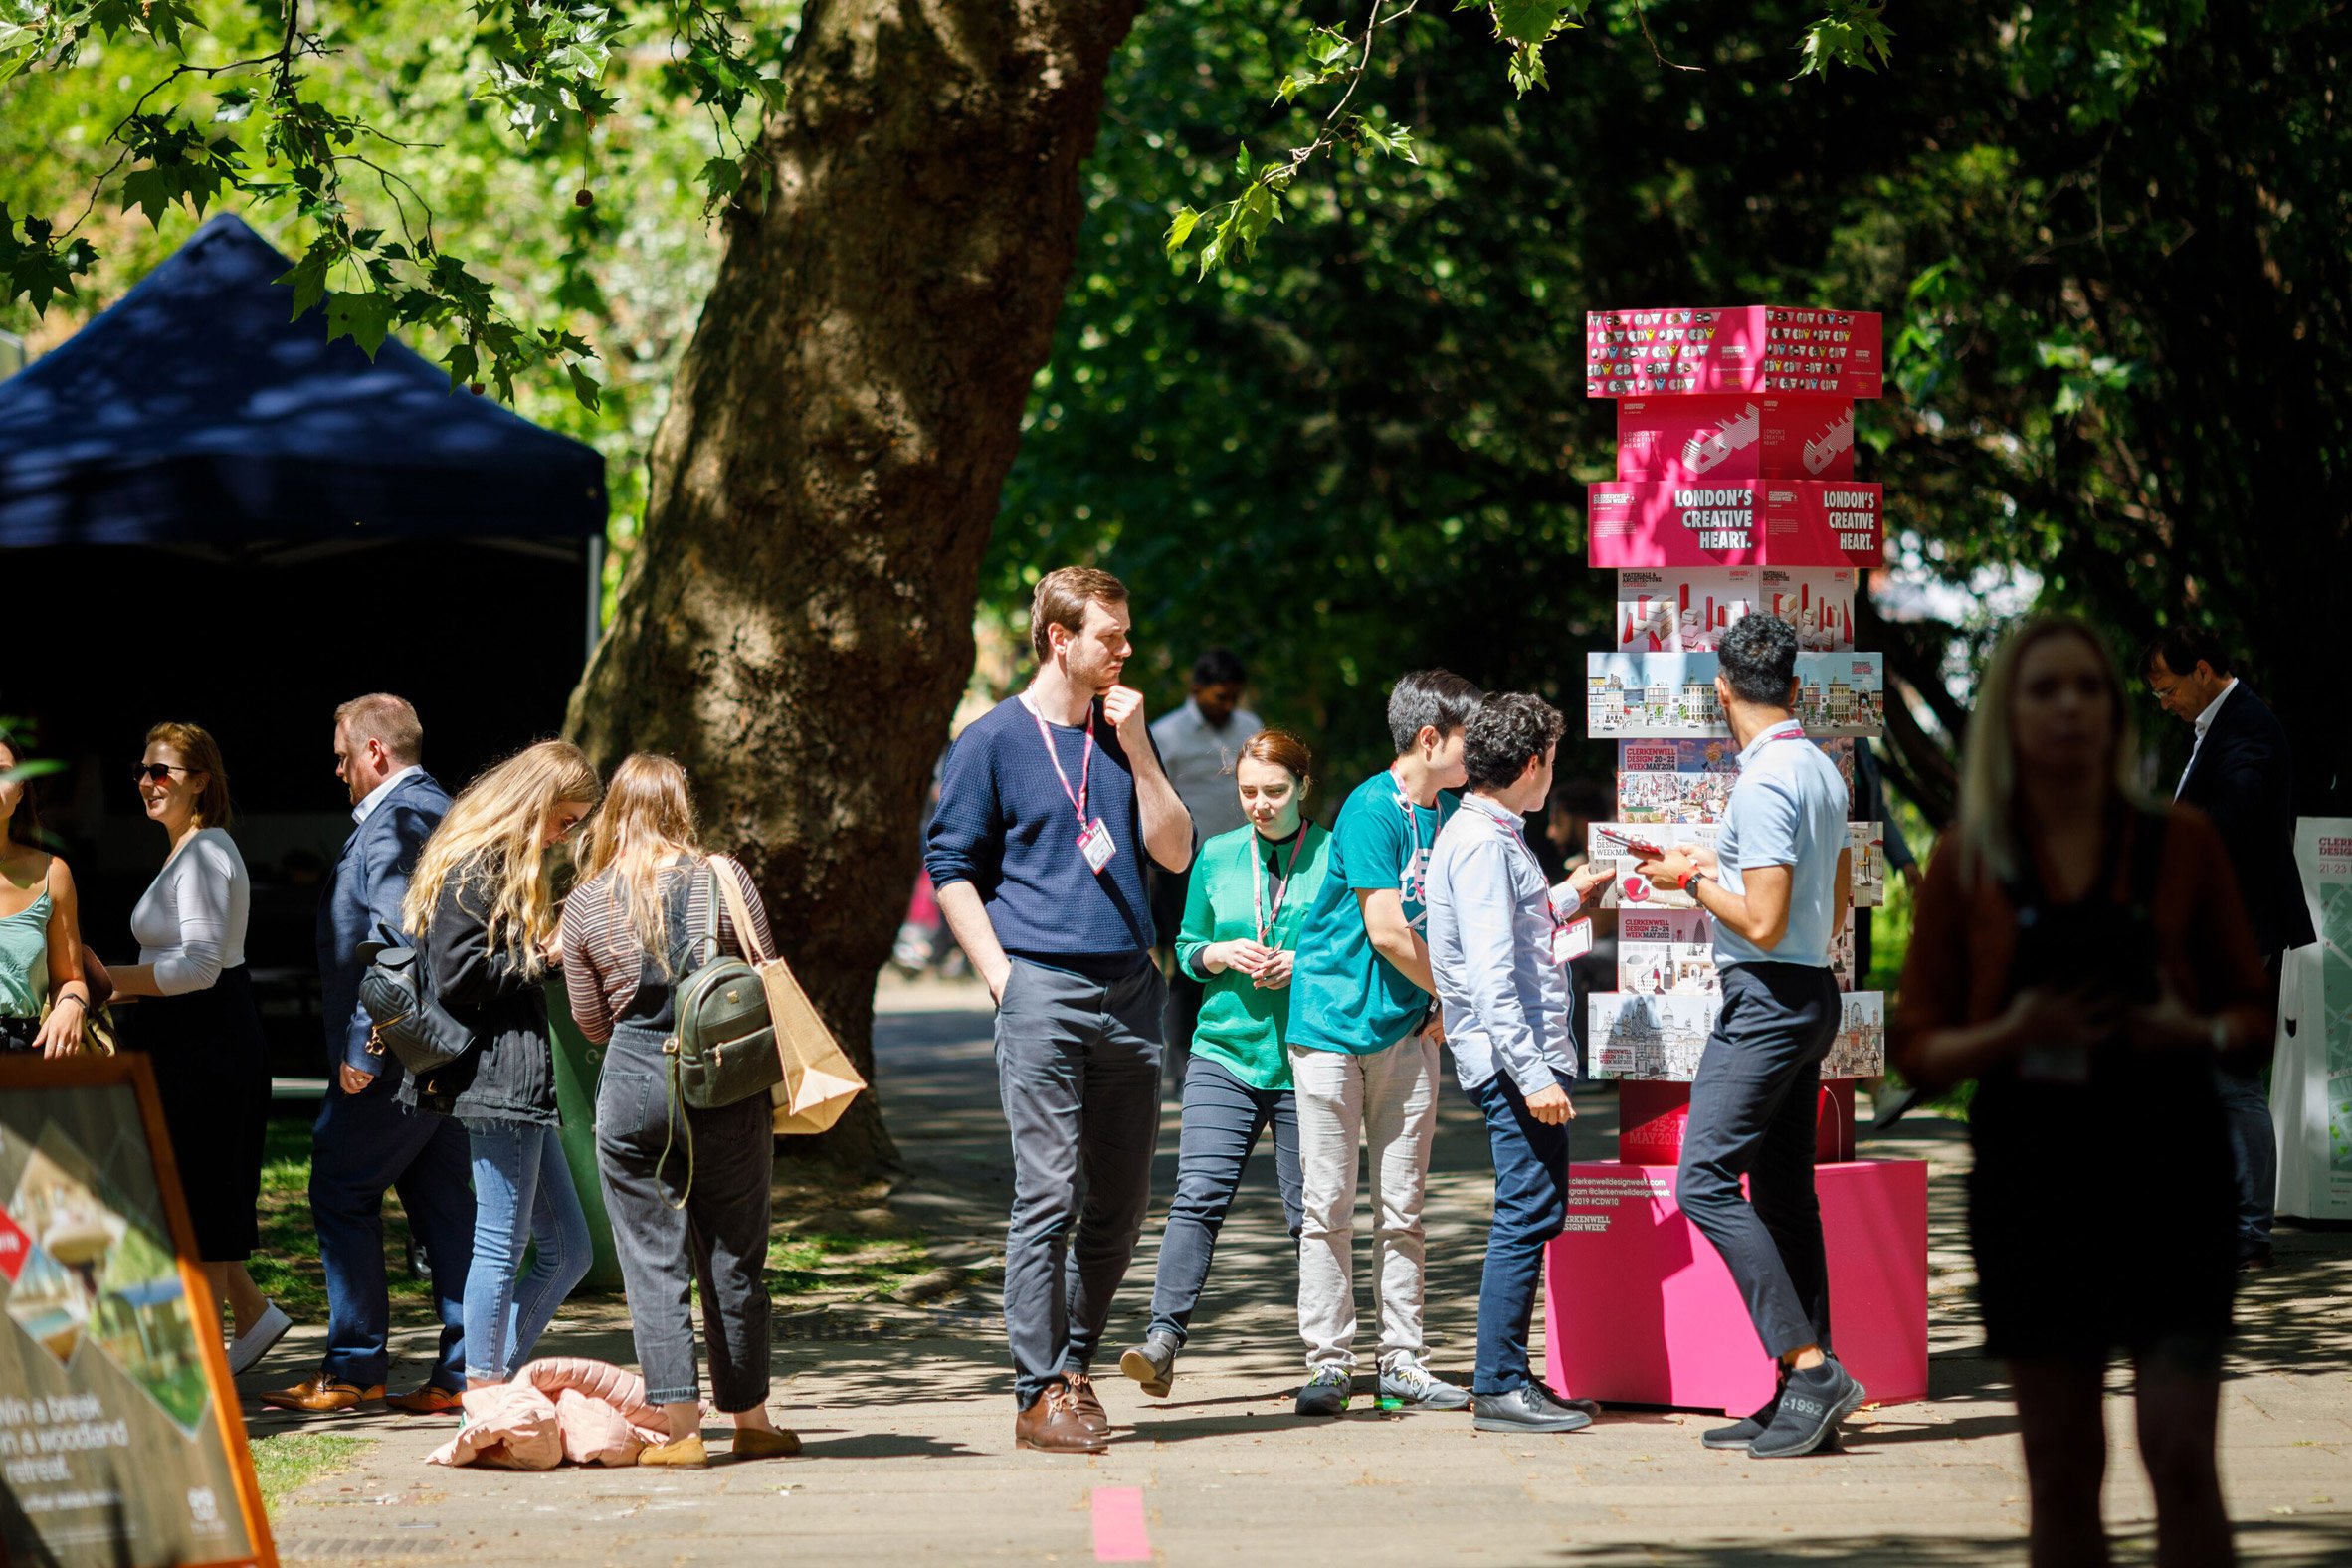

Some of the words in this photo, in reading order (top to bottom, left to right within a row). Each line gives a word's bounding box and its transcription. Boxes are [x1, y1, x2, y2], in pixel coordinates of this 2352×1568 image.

[1674, 490, 1752, 507] LONDON'S
[1823, 490, 1874, 509] LONDON'S
[1682, 509, 1752, 528] CREATIVE
[1829, 511, 1874, 530] CREATIVE
[1699, 531, 1752, 549] HEART.
[1840, 532, 1874, 551] HEART.
[1626, 747, 1675, 756] CLERKENWELL
[1629, 1132, 1657, 1145] MAY
[1569, 1178, 1666, 1187] .clerkenwelldesignweek.com
